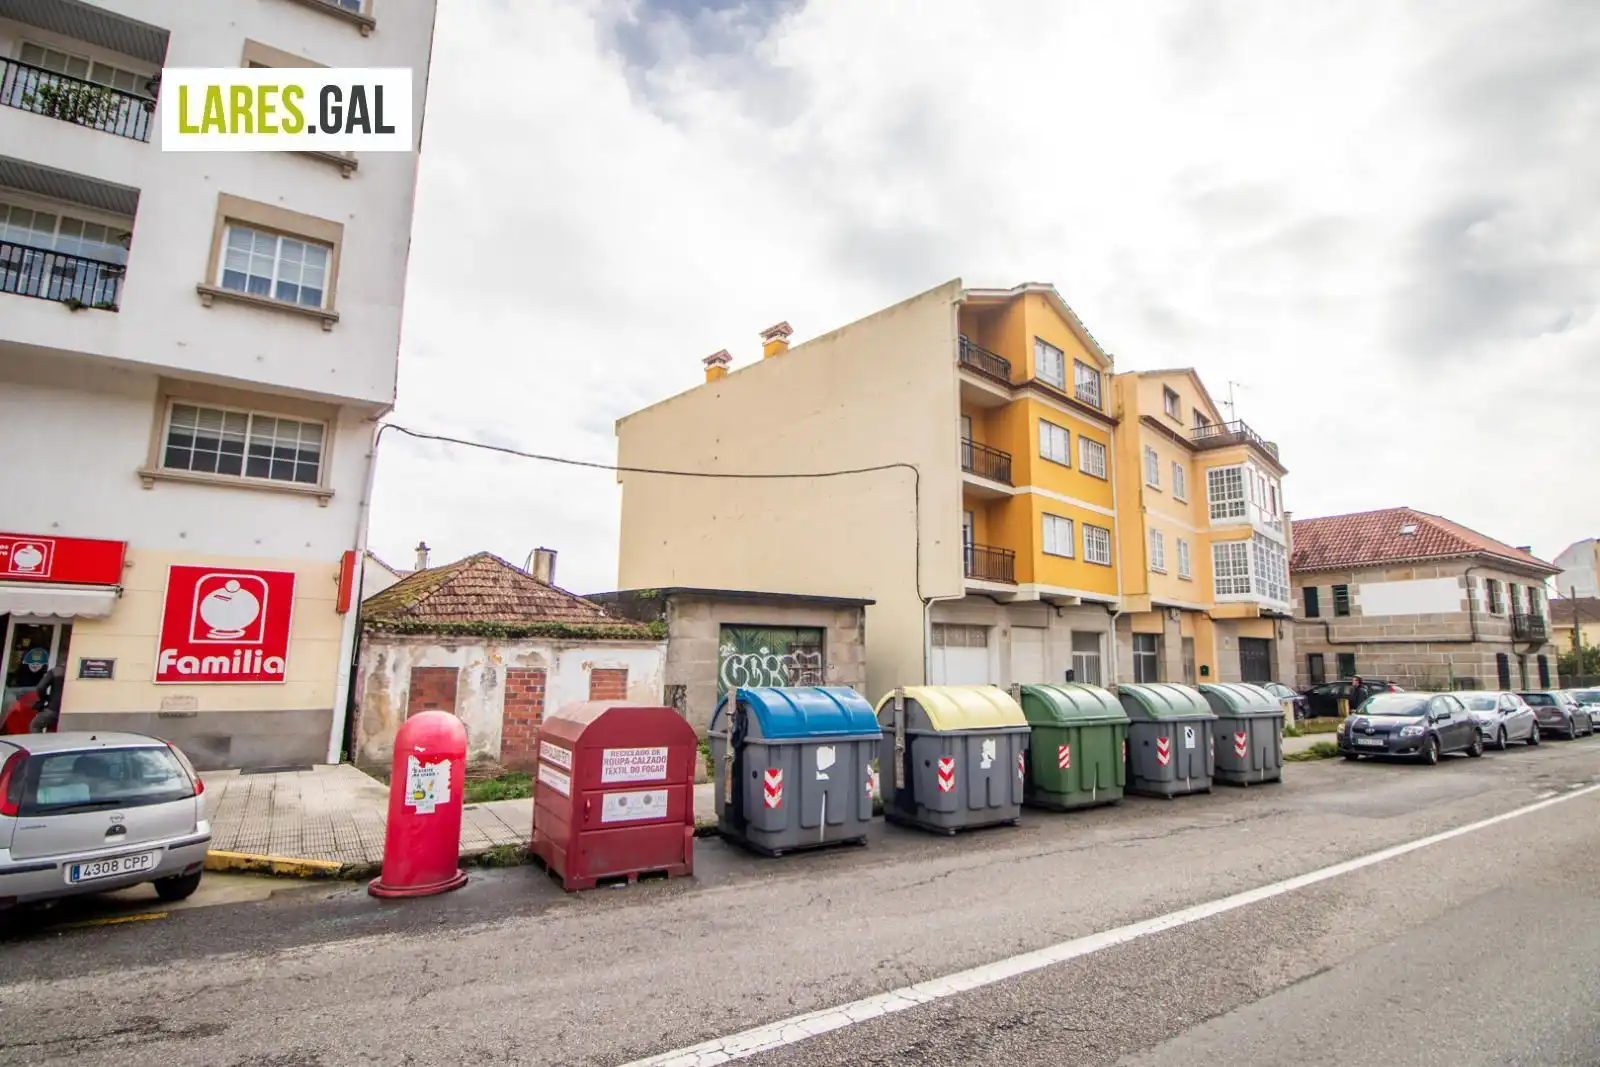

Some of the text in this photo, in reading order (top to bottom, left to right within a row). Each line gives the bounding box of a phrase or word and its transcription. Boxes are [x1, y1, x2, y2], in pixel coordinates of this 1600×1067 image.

[158, 648, 285, 675] Familia
[642, 765, 665, 773] FOGAR
[83, 855, 149, 878] 4308 CPP
